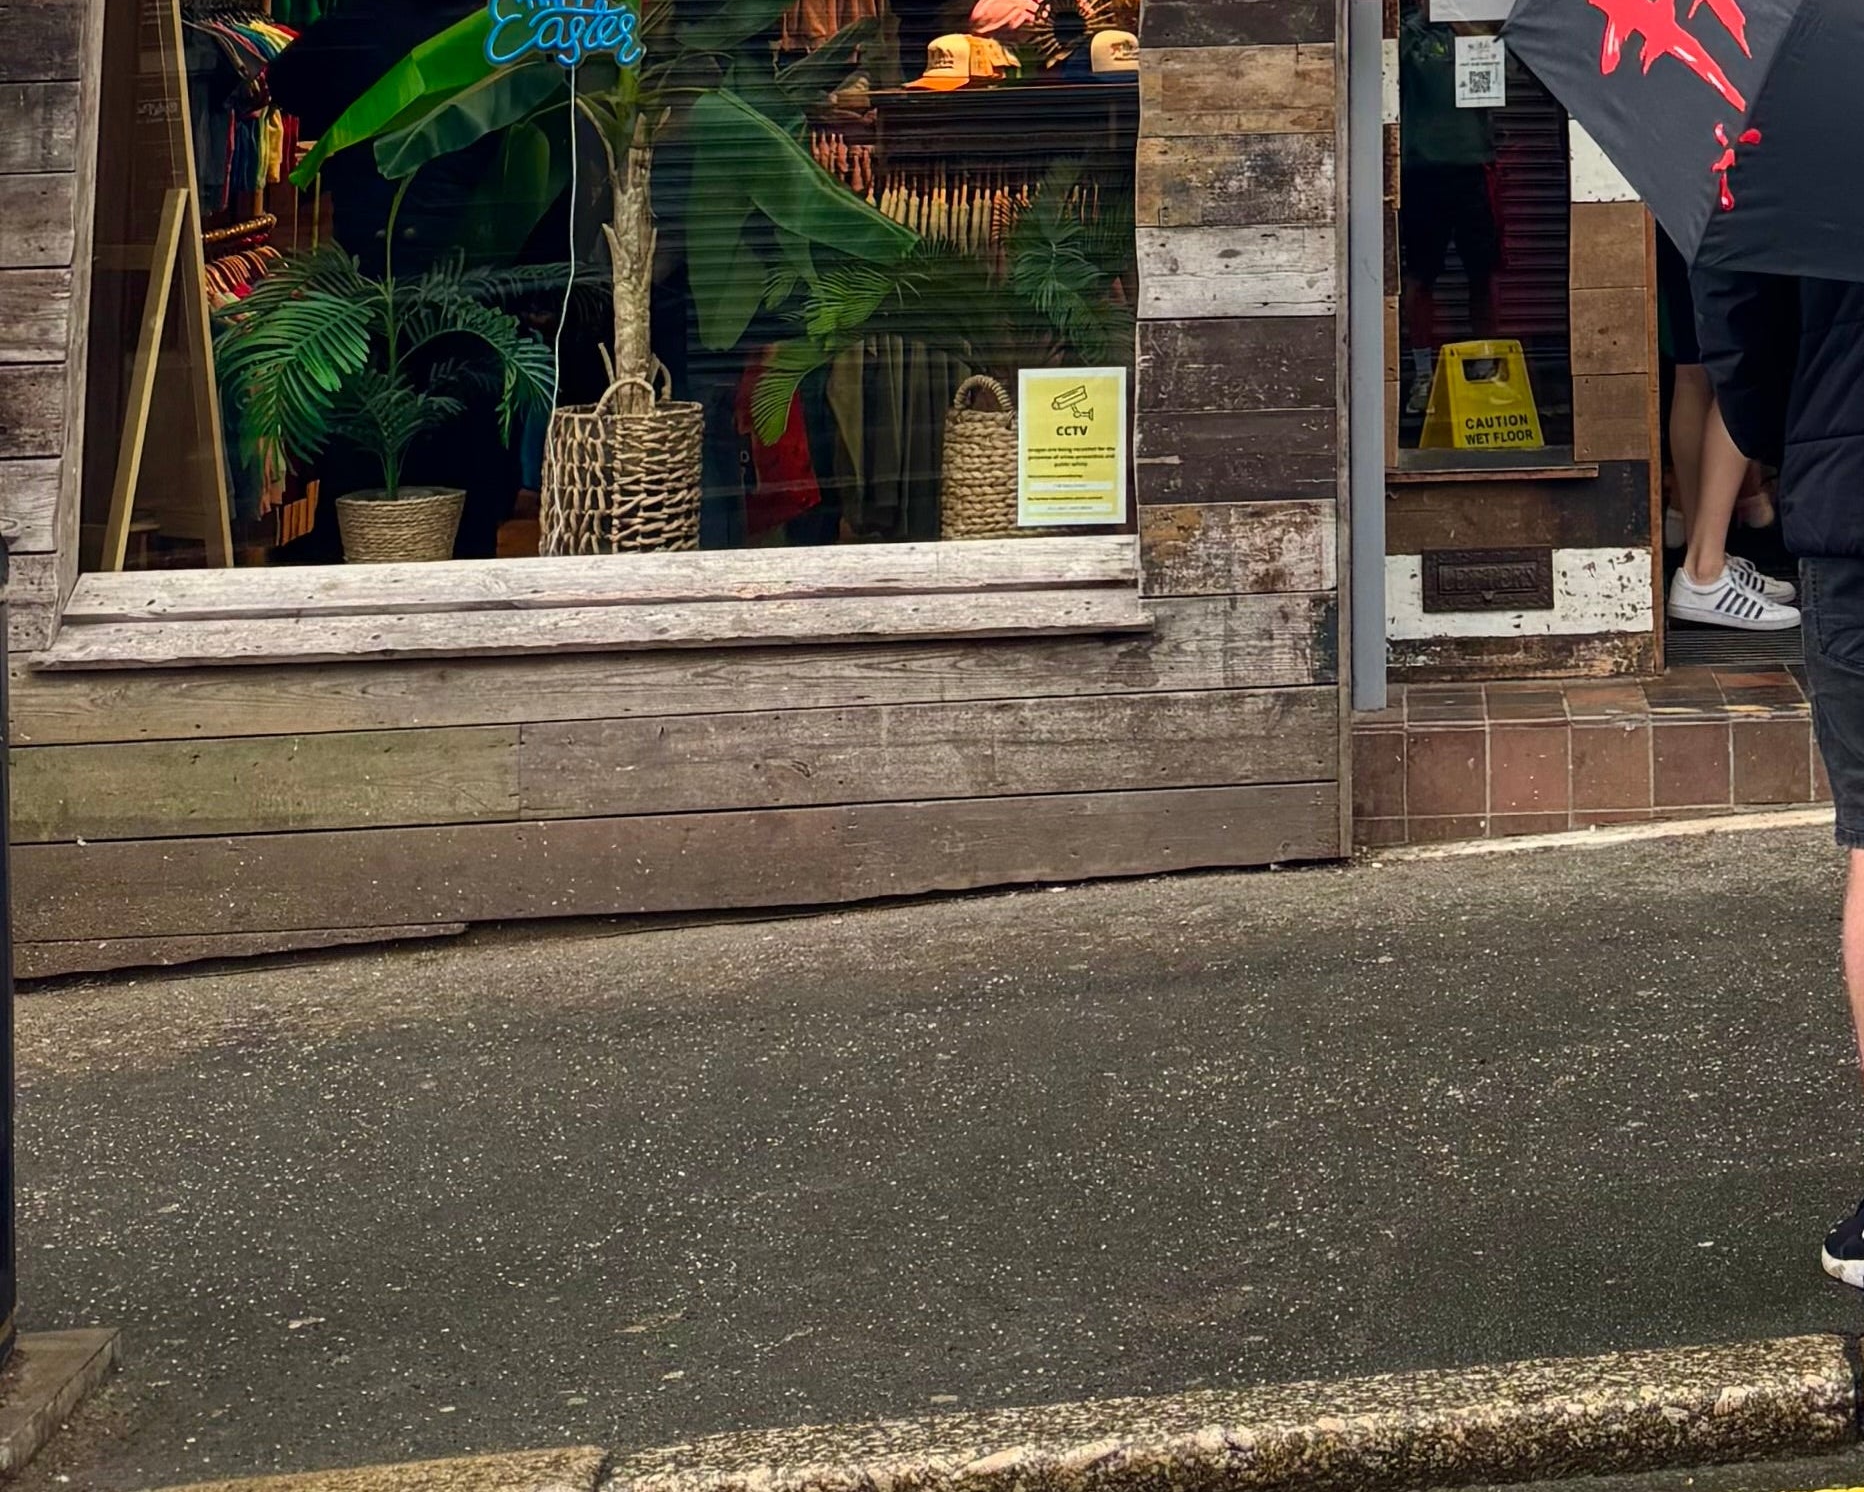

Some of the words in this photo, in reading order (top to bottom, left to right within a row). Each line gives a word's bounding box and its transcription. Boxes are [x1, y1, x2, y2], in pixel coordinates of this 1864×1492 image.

[1465, 414, 1528, 430] CAUTION
[1056, 425, 1088, 436] CCTV
[1464, 433, 1490, 446] WET
[1493, 429, 1534, 443] FLOOR
